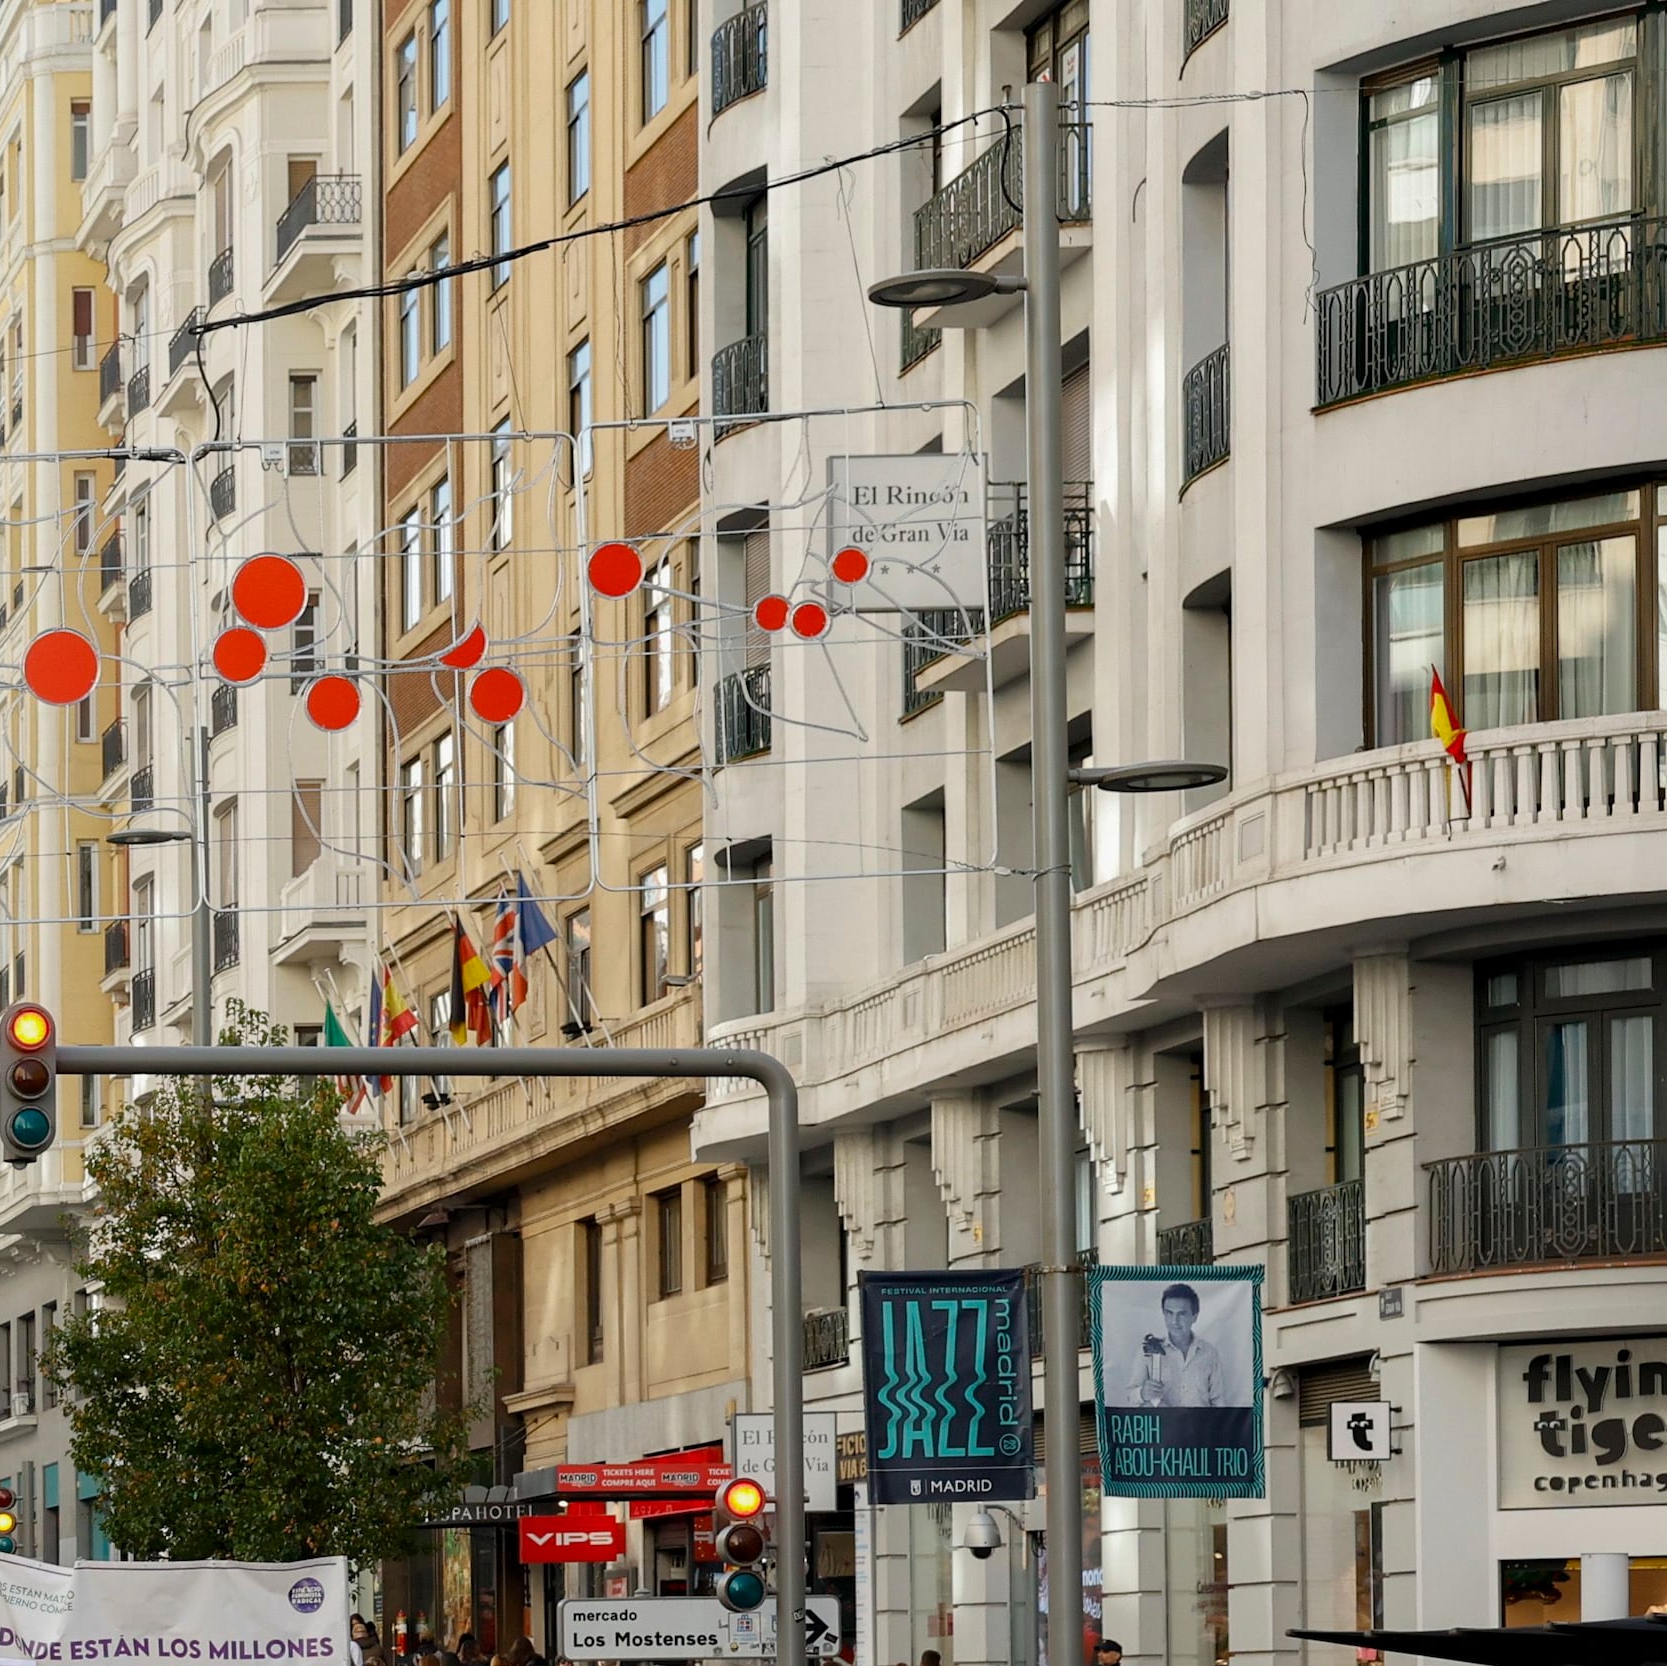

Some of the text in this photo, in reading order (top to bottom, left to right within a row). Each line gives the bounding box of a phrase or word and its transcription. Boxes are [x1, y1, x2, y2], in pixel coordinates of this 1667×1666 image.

[853, 485, 969, 505] El Rincón
[852, 526, 874, 542] de
[882, 524, 929, 542] Gran
[881, 1286, 1008, 1295] FESTIVAL INTERNACIONAL
[999, 1298, 1019, 1427] madrid
[1523, 1349, 1667, 1413] flyin
[1111, 1415, 1160, 1441] RABIH
[1534, 1405, 1667, 1466] tige
[1115, 1447, 1248, 1477] ABOU-KHALIL TRIO
[930, 1479, 992, 1493] MADRID
[1534, 1469, 1667, 1494] copenhag
[526, 1532, 614, 1546] VIPS
[573, 1610, 637, 1622] mercado
[70, 1634, 150, 1660] ESTÁN
[158, 1638, 202, 1658] LOS
[208, 1637, 335, 1661] MILLONES
[573, 1632, 718, 1647] Los Mostenses
